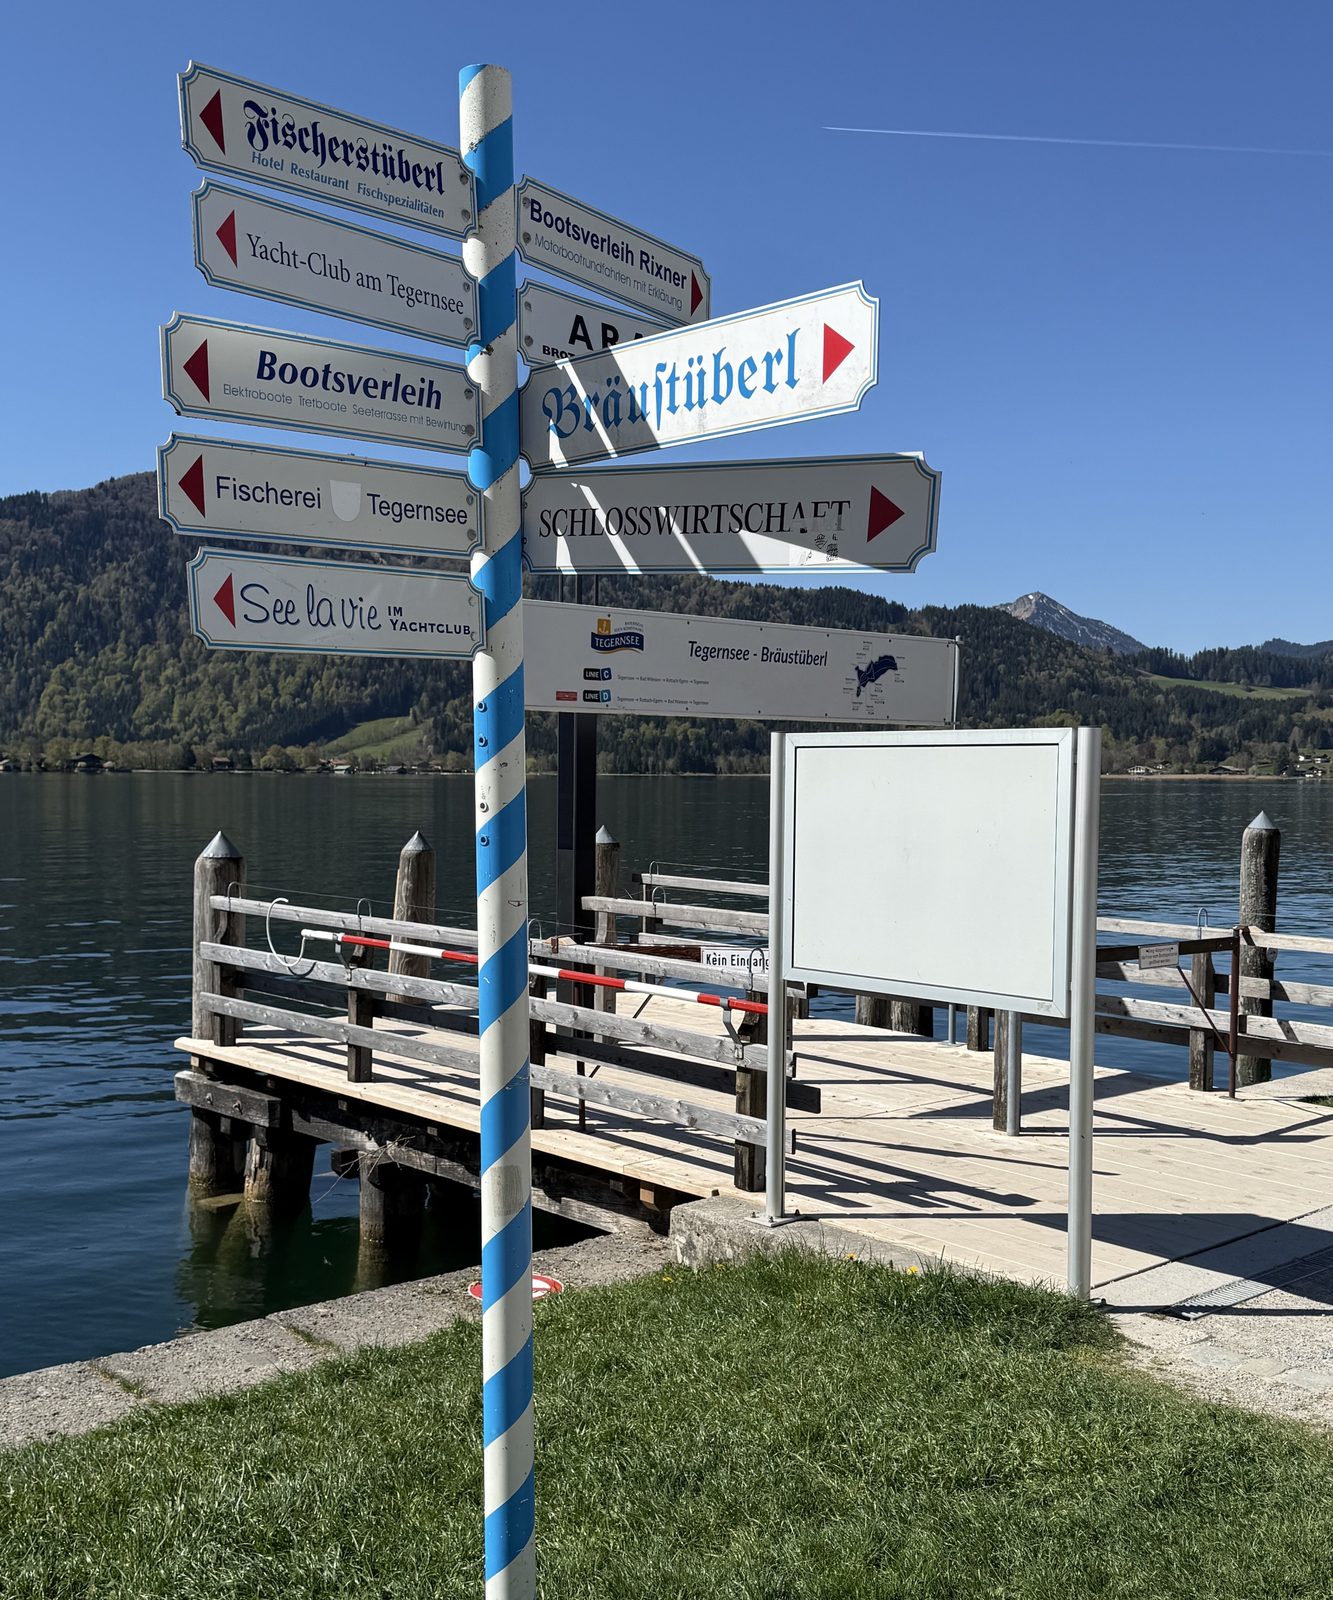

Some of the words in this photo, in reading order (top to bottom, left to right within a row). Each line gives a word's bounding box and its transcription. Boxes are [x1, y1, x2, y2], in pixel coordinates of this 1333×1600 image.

[243, 99, 446, 196] Fischerstüberl
[251, 151, 285, 171] Hotel
[290, 163, 350, 191] Restaurant
[357, 182, 445, 218] Fischspezialitäten
[529, 198, 635, 267] Bootsverleih
[640, 250, 688, 290] Rixner
[246, 232, 351, 283] Yacht-Club
[356, 270, 382, 292] am
[386, 273, 464, 315] Tegernsee
[534, 233, 632, 287] Motorbootrundfahrten
[633, 275, 647, 294] mit
[648, 284, 683, 312] Erklärung
[568, 314, 644, 351] AR
[256, 350, 442, 410] Bootsverleih
[223, 383, 293, 405] Elektroboote
[298, 395, 348, 413] Tretboote
[352, 404, 408, 423] Seeterrasse
[409, 414, 425, 425] mit
[426, 415, 468, 435] Bewirtung
[215, 475, 322, 509] Fischerei
[366, 492, 468, 525] Tegernsee
[240, 583, 300, 624] See
[388, 605, 403, 617] IM
[390, 618, 471, 636] YACHTCLUB
[595, 635, 640, 648] TEGERNSEE
[585, 670, 599, 679] LINIE
[603, 669, 610, 679] C
[688, 640, 750, 662] Tegernsee
[761, 646, 828, 667] Bräustüberl
[585, 692, 599, 700] LINIE
[602, 691, 609, 700] D
[706, 953, 727, 966] Kein
